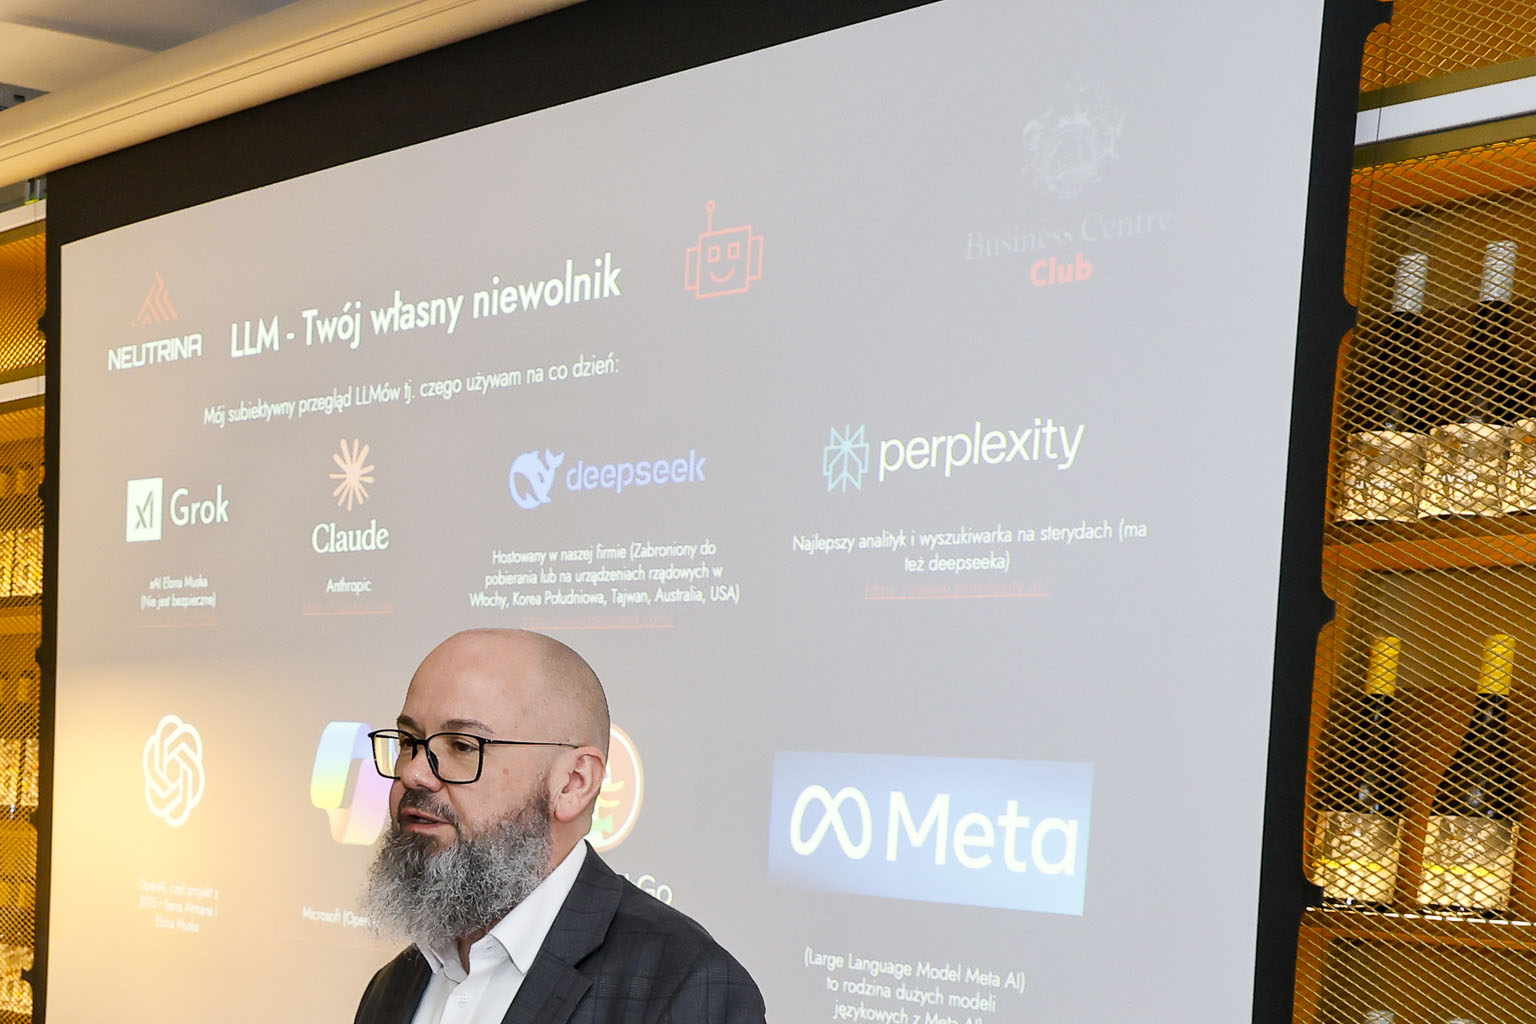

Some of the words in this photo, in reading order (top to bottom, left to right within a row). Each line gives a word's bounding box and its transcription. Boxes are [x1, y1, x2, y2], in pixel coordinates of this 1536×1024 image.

[1029, 253, 1094, 287] Club
[231, 314, 279, 358] LLM
[301, 301, 361, 349] Twój
[370, 290, 464, 334] własny
[472, 252, 621, 319] niewolnik
[107, 333, 203, 371] NEUTRINA
[204, 404, 226, 428] Mój
[228, 398, 296, 422] subiektywny
[299, 386, 351, 418] przegląd
[356, 381, 401, 406] LLMów
[420, 378, 462, 400] czego
[466, 370, 522, 395] używam
[526, 368, 544, 384] na
[548, 365, 568, 381] co
[572, 351, 619, 379] dzień:
[878, 418, 1085, 481] perplexity
[565, 450, 707, 493] deepseek
[170, 484, 230, 526] Grok
[311, 518, 390, 554] Claude
[492, 550, 546, 566] Hostowany
[549, 553, 558, 562] w
[560, 546, 594, 564] naszej
[596, 543, 627, 560] firmie
[630, 541, 697, 561] (Zabroniony
[700, 538, 716, 555] do
[792, 533, 855, 555] Najlepszy
[858, 532, 906, 552] analityk
[918, 525, 1013, 549] wyszukiwarka
[1017, 526, 1035, 543] na
[1040, 520, 1112, 543] sterydach
[1117, 518, 1148, 542] (ma
[485, 570, 537, 588] pobierania
[541, 568, 557, 584] lub
[559, 571, 572, 582] na
[575, 565, 645, 586] urządzeniach
[648, 562, 709, 582] rządowych
[712, 566, 723, 577] w
[904, 555, 925, 573] też
[928, 550, 1011, 575] deepseeka)
[325, 576, 373, 596] Anthropic
[512, 591, 541, 606] Korea
[544, 588, 607, 606] Południowa,
[610, 587, 651, 605] Tajwan,
[654, 584, 706, 603] Australia,
[710, 584, 740, 604] USA)
[886, 791, 1078, 876] Meta
[805, 946, 844, 971] (Large
[848, 953, 913, 980] Language
[916, 962, 962, 983] Model
[964, 968, 1001, 987] Meta
[1004, 971, 1026, 994] AI)
[826, 976, 839, 992] to
[842, 977, 892, 999] rodzina
[895, 982, 944, 1007] dużych
[948, 992, 997, 1013] modeli
